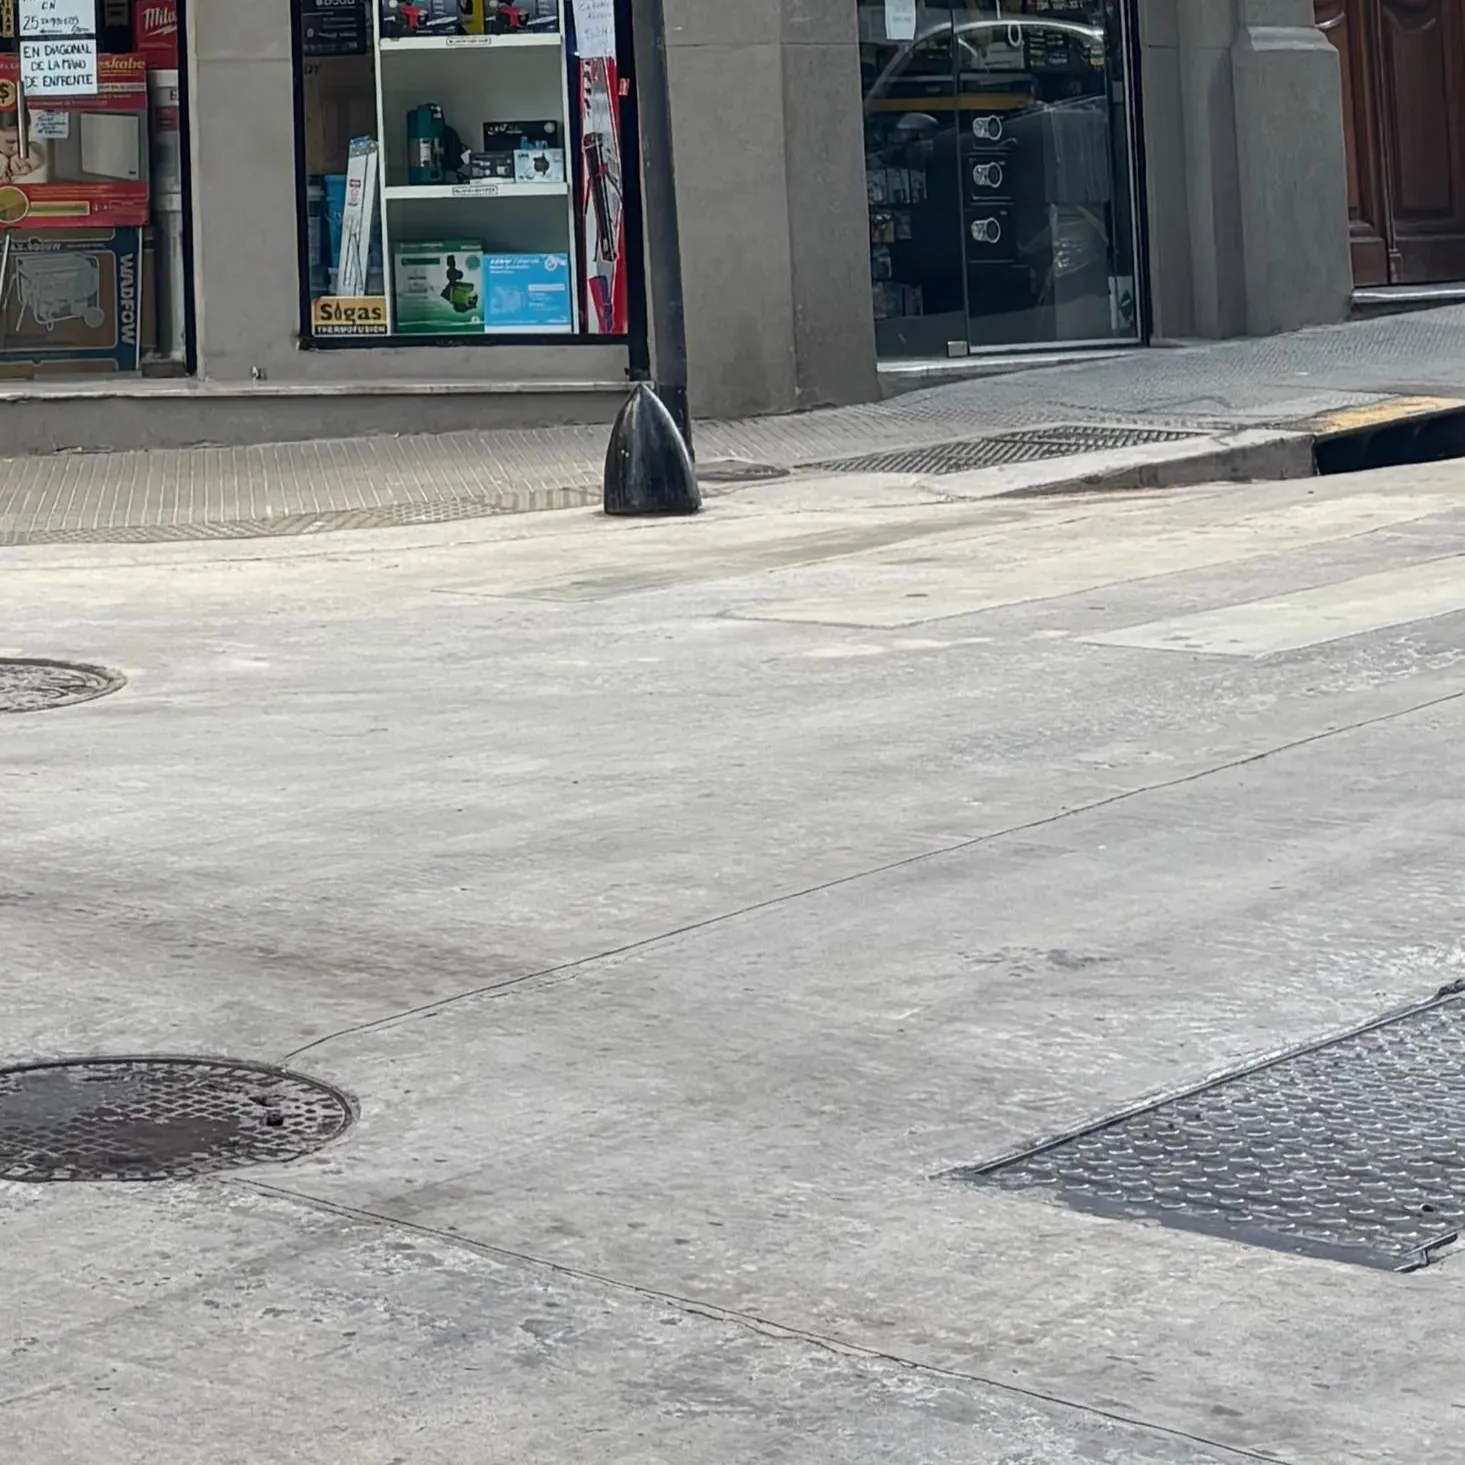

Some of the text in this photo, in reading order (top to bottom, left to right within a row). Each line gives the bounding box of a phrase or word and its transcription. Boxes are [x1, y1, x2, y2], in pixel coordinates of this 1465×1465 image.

[23, 15, 39, 30] 25
[23, 43, 92, 58] EN DIAGONAL
[30, 60, 45, 72] DE
[48, 59, 61, 71] LA
[119, 252, 137, 345] WADFOW
